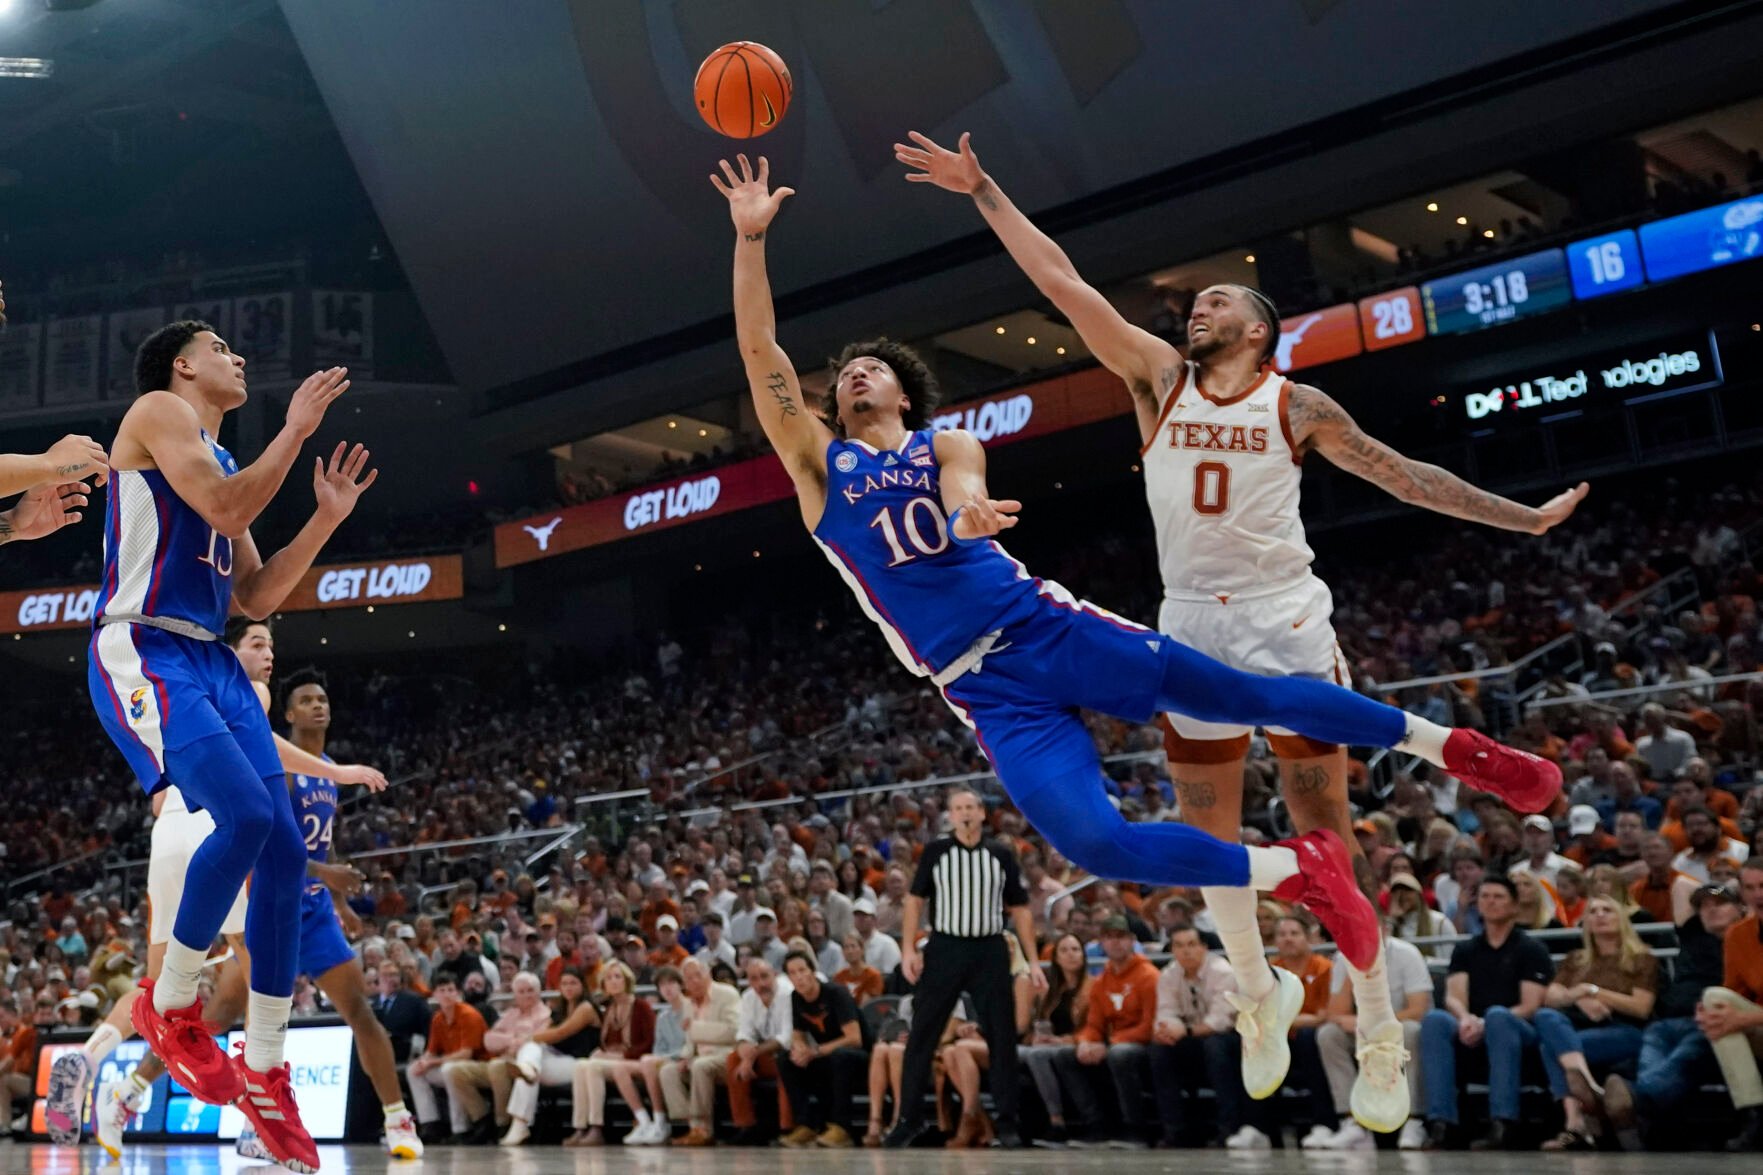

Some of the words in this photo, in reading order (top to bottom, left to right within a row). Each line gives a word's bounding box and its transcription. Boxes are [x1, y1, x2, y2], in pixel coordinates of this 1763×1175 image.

[1586, 241, 1625, 285] 16
[1463, 270, 1528, 314] 3:18
[1372, 296, 1414, 339] 28
[965, 394, 1033, 442] LOUD
[1168, 420, 1270, 454] TEXAS
[624, 489, 665, 530] GET
[665, 475, 721, 519] LOUD
[842, 470, 937, 505] KANSA
[1192, 459, 1232, 517] 0
[869, 497, 949, 567] 10
[317, 568, 367, 603] GET
[366, 562, 432, 598] LOUD
[18, 592, 64, 627] GET
[63, 589, 101, 622] LO
[303, 813, 333, 851] 24
